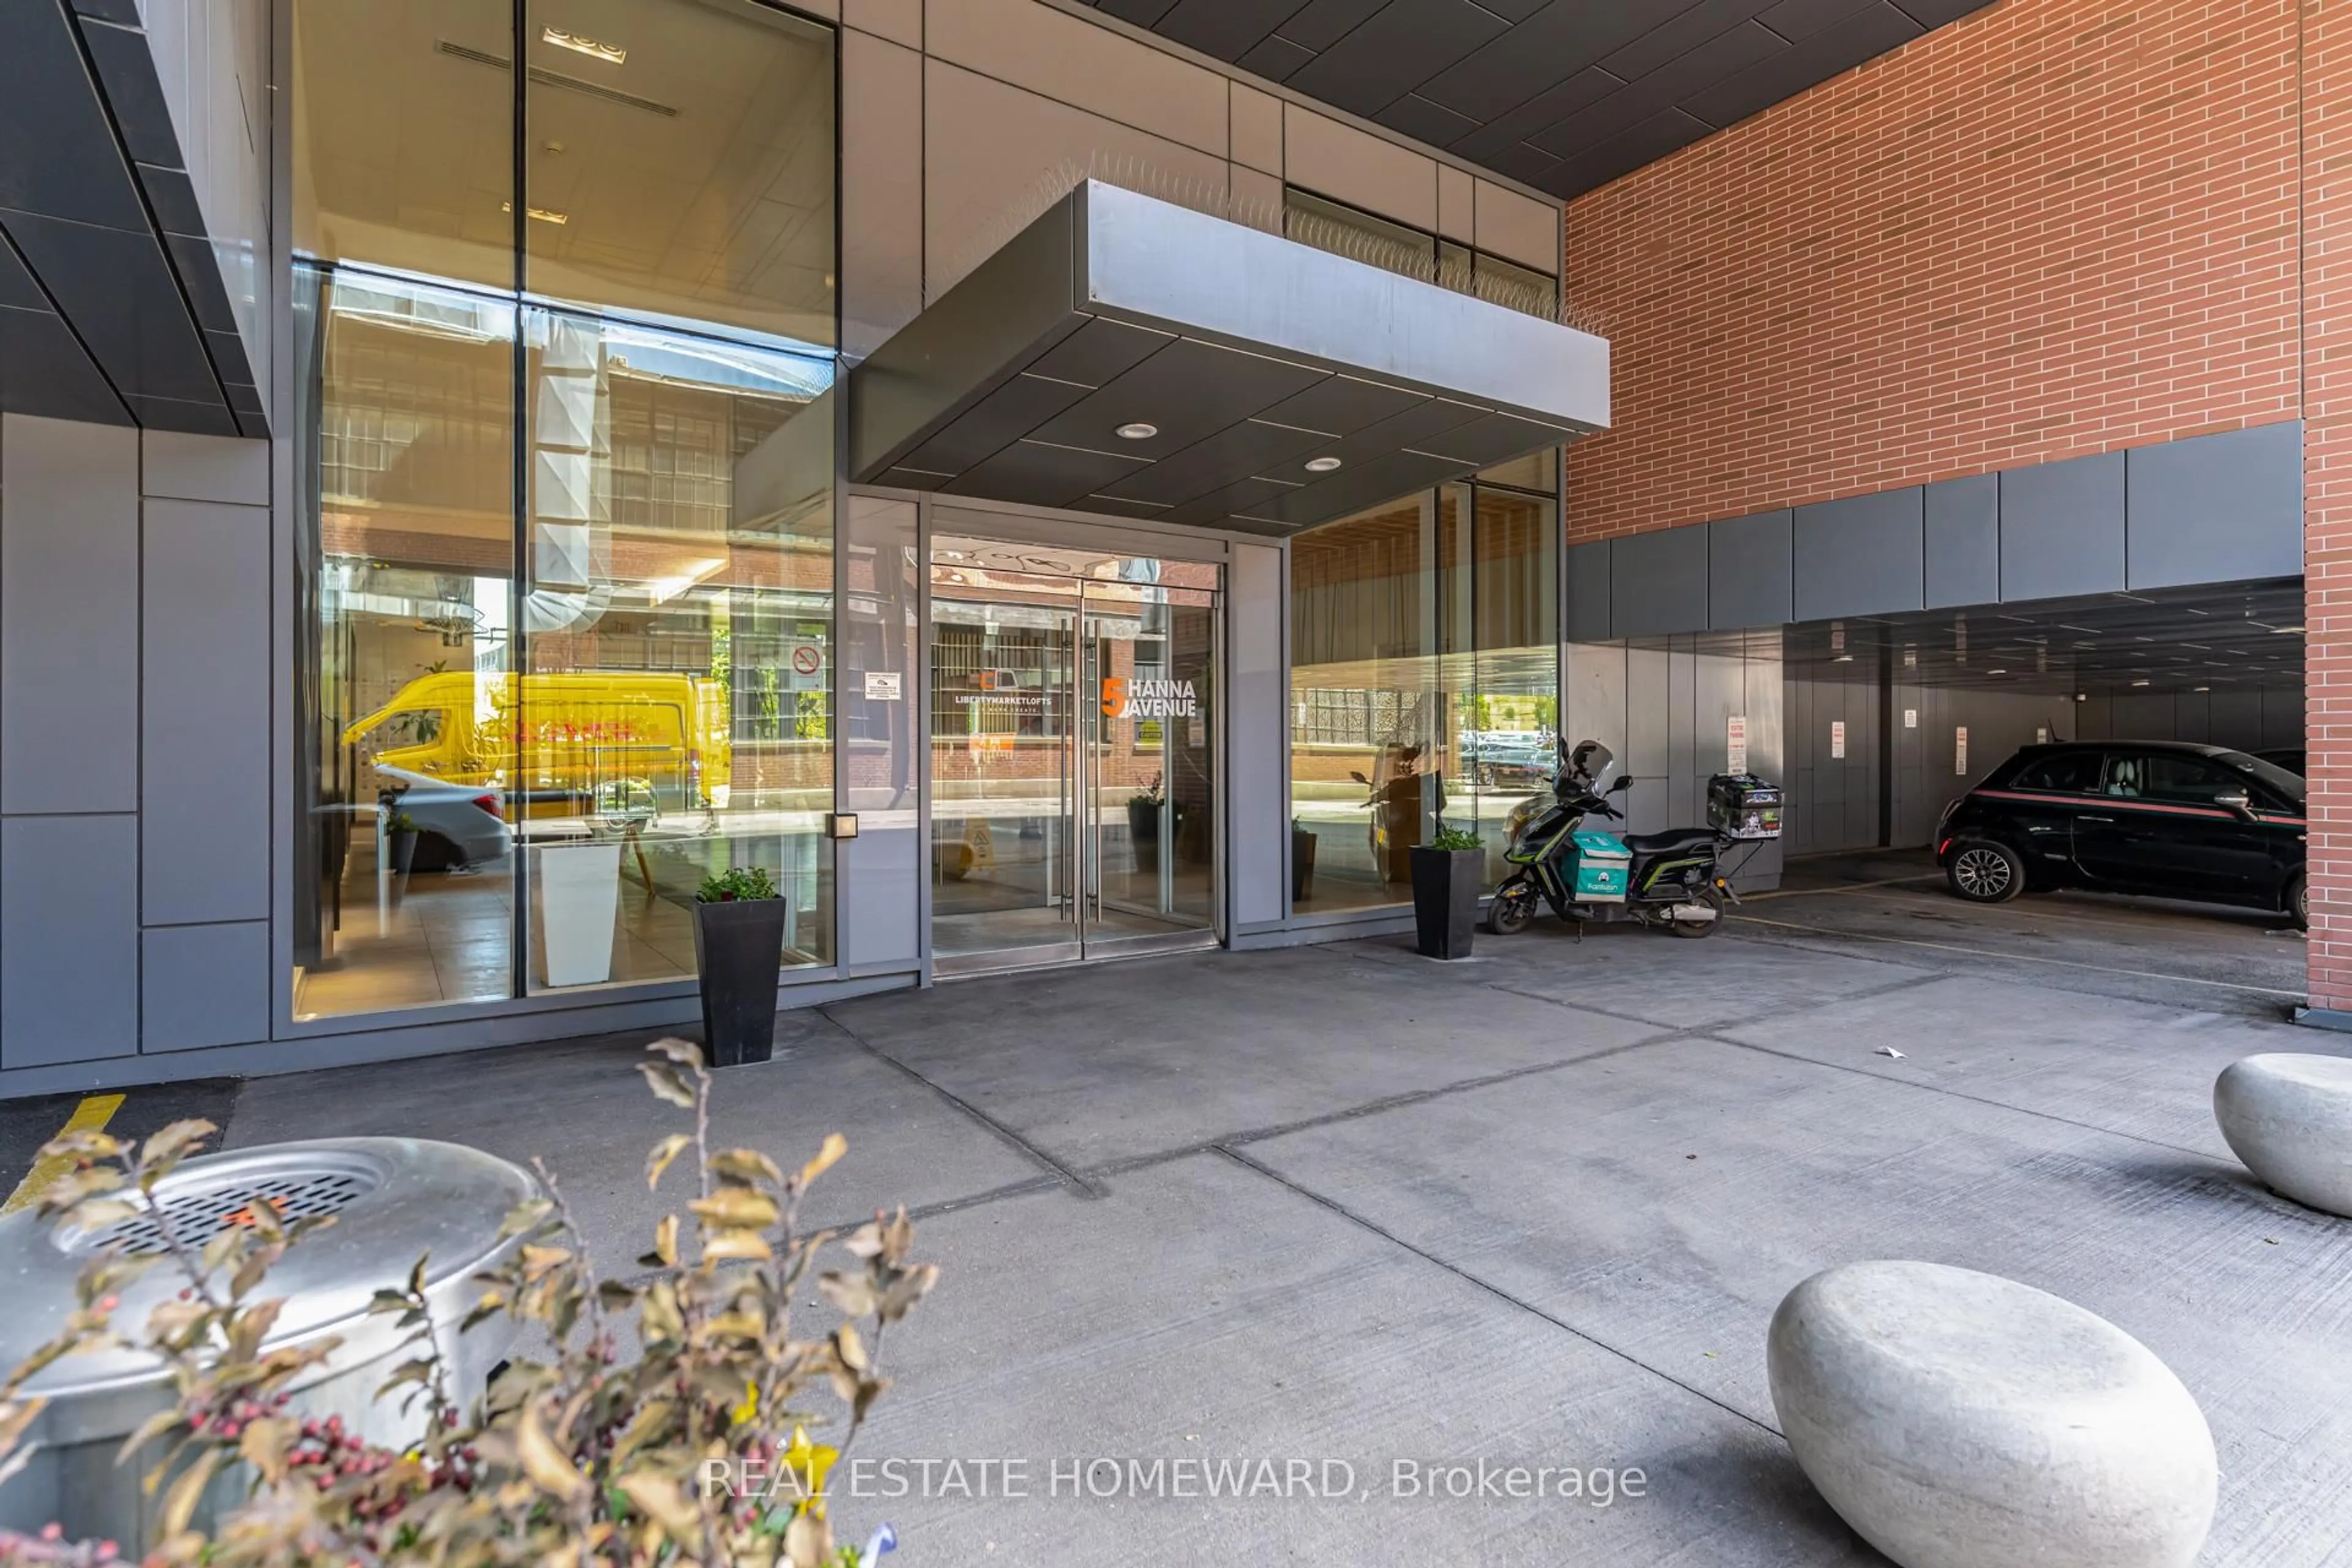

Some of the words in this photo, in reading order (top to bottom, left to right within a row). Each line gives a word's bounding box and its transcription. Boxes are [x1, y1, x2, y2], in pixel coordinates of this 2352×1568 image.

[1102, 677, 1125, 718] 5
[1128, 679, 1196, 698] HANNA
[1128, 699, 1196, 717] AVENUE
